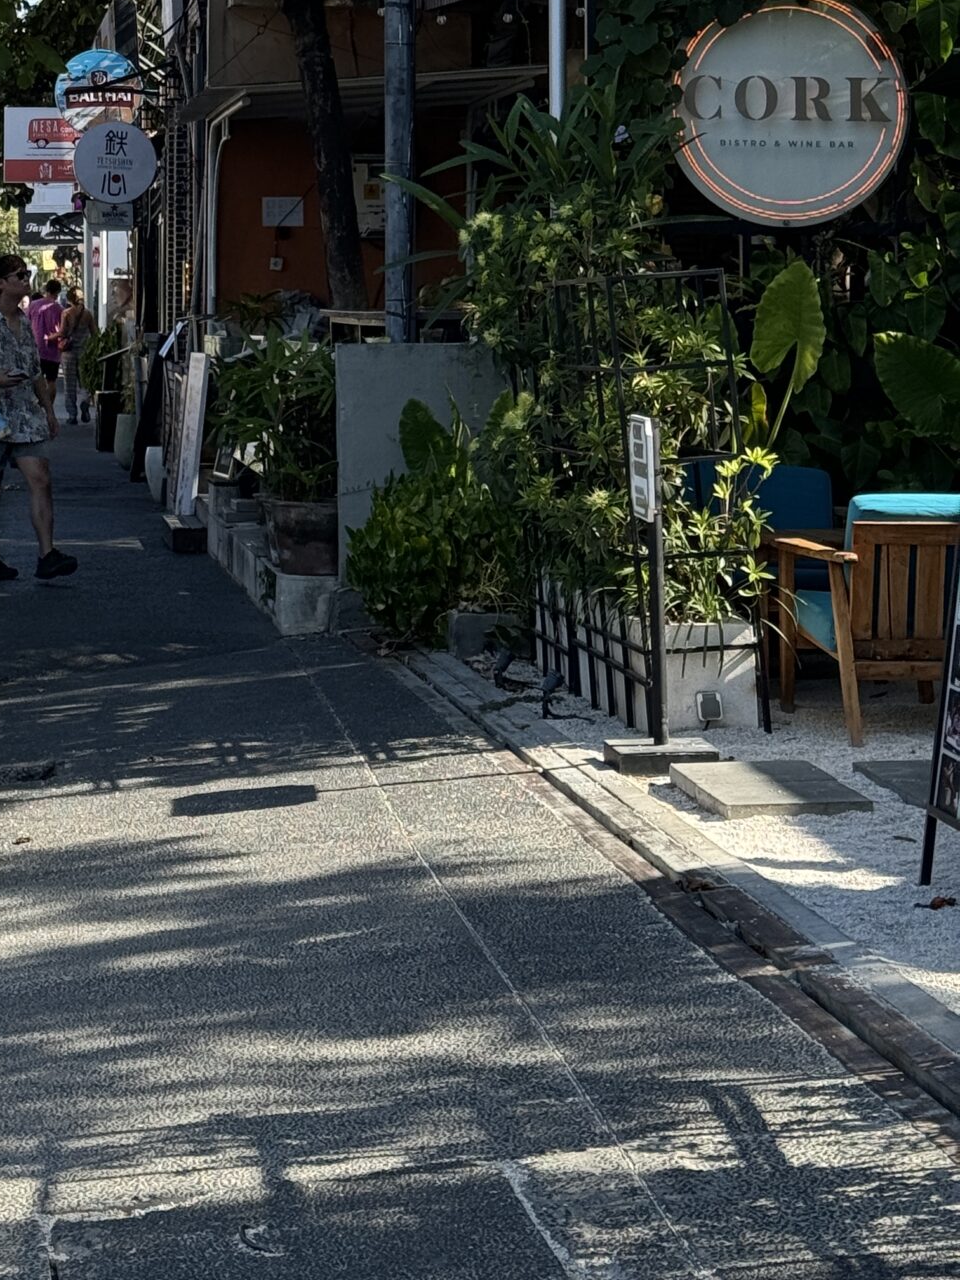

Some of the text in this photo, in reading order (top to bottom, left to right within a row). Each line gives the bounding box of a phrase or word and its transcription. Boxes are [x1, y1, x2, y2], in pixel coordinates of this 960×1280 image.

[68, 91, 132, 103] BALI HAI
[683, 75, 892, 122] CORK
[32, 120, 59, 133] NESA
[719, 139, 855, 150] BISTRO & WINE BAR
